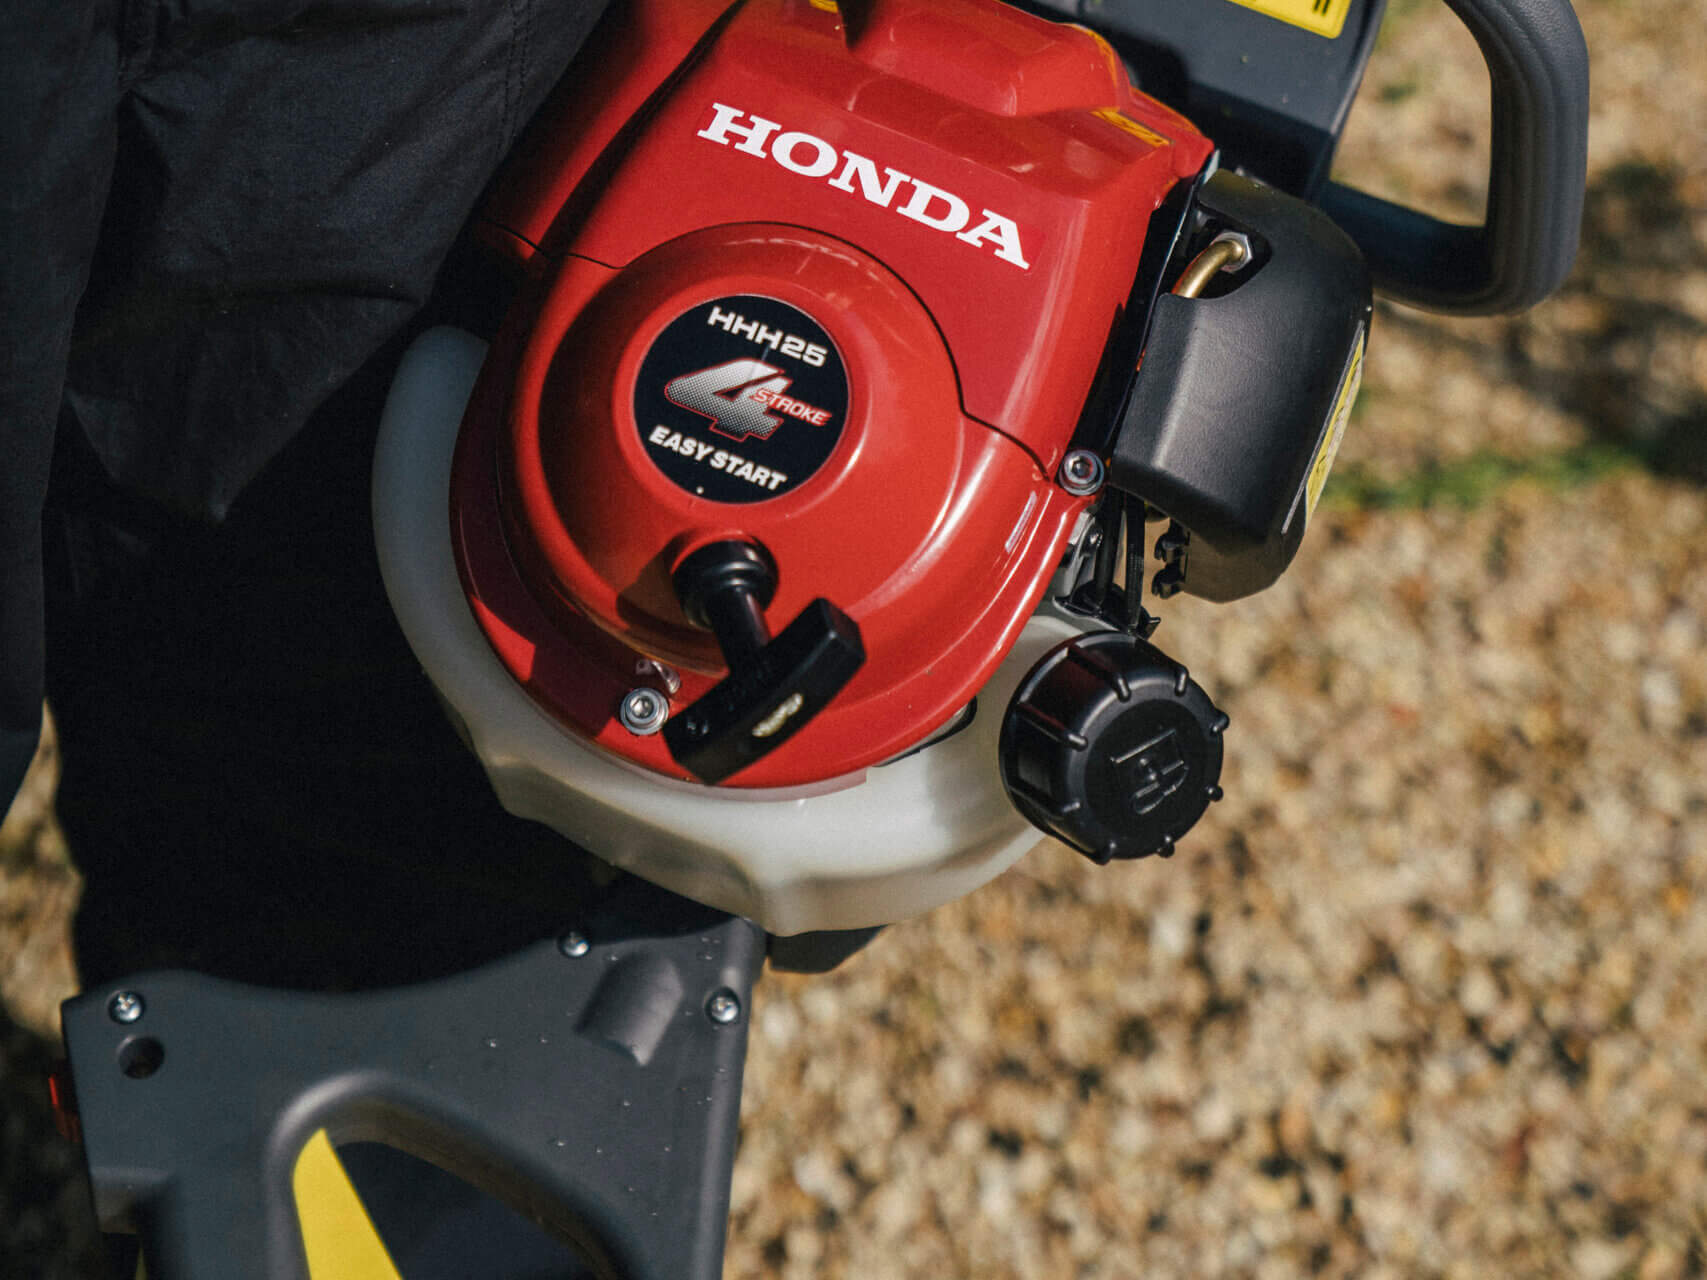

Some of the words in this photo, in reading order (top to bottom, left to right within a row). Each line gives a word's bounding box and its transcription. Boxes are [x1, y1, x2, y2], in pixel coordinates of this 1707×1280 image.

[697, 102, 1030, 270] HONDA
[706, 305, 828, 367] HHH25
[664, 357, 793, 442] 4
[751, 387, 832, 426] STROKE
[649, 424, 715, 462] EASY
[709, 450, 788, 491] START
